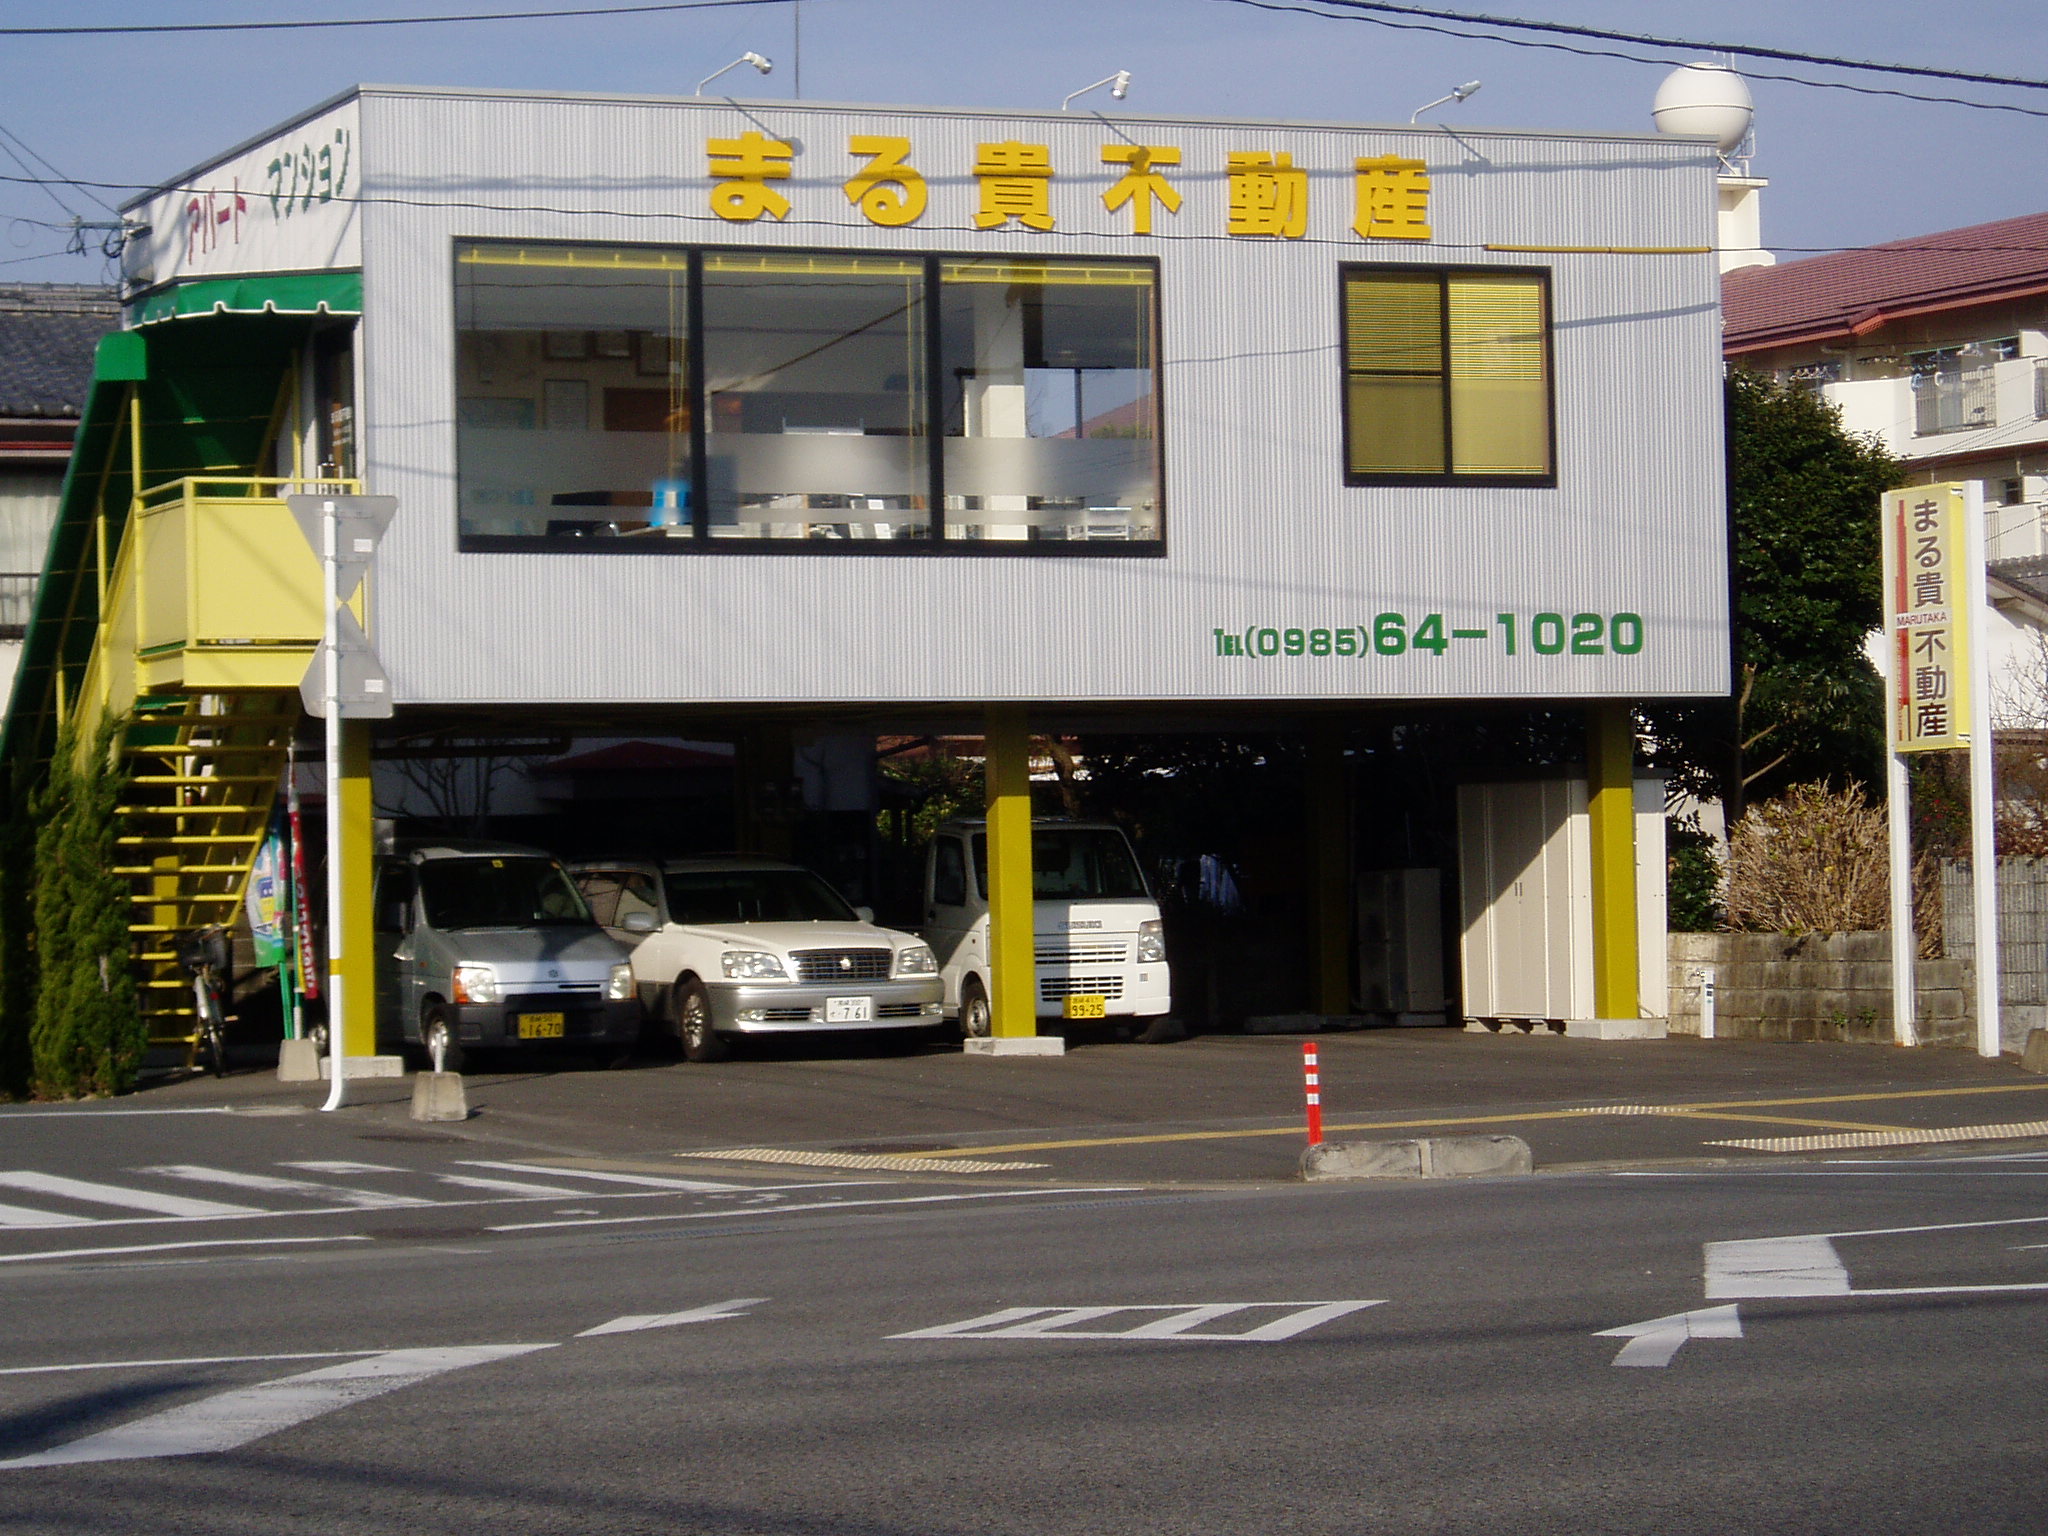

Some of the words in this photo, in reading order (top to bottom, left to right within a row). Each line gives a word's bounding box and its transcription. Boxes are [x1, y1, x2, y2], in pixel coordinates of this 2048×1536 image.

[706, 131, 1431, 240] まる貴不動産
[187, 176, 246, 265] アパート
[267, 127, 350, 226] マンション
[1896, 612, 1947, 627] MARUTAKA
[1072, 1004, 1103, 1016] 99-25
[529, 1023, 562, 1036] 16-70
